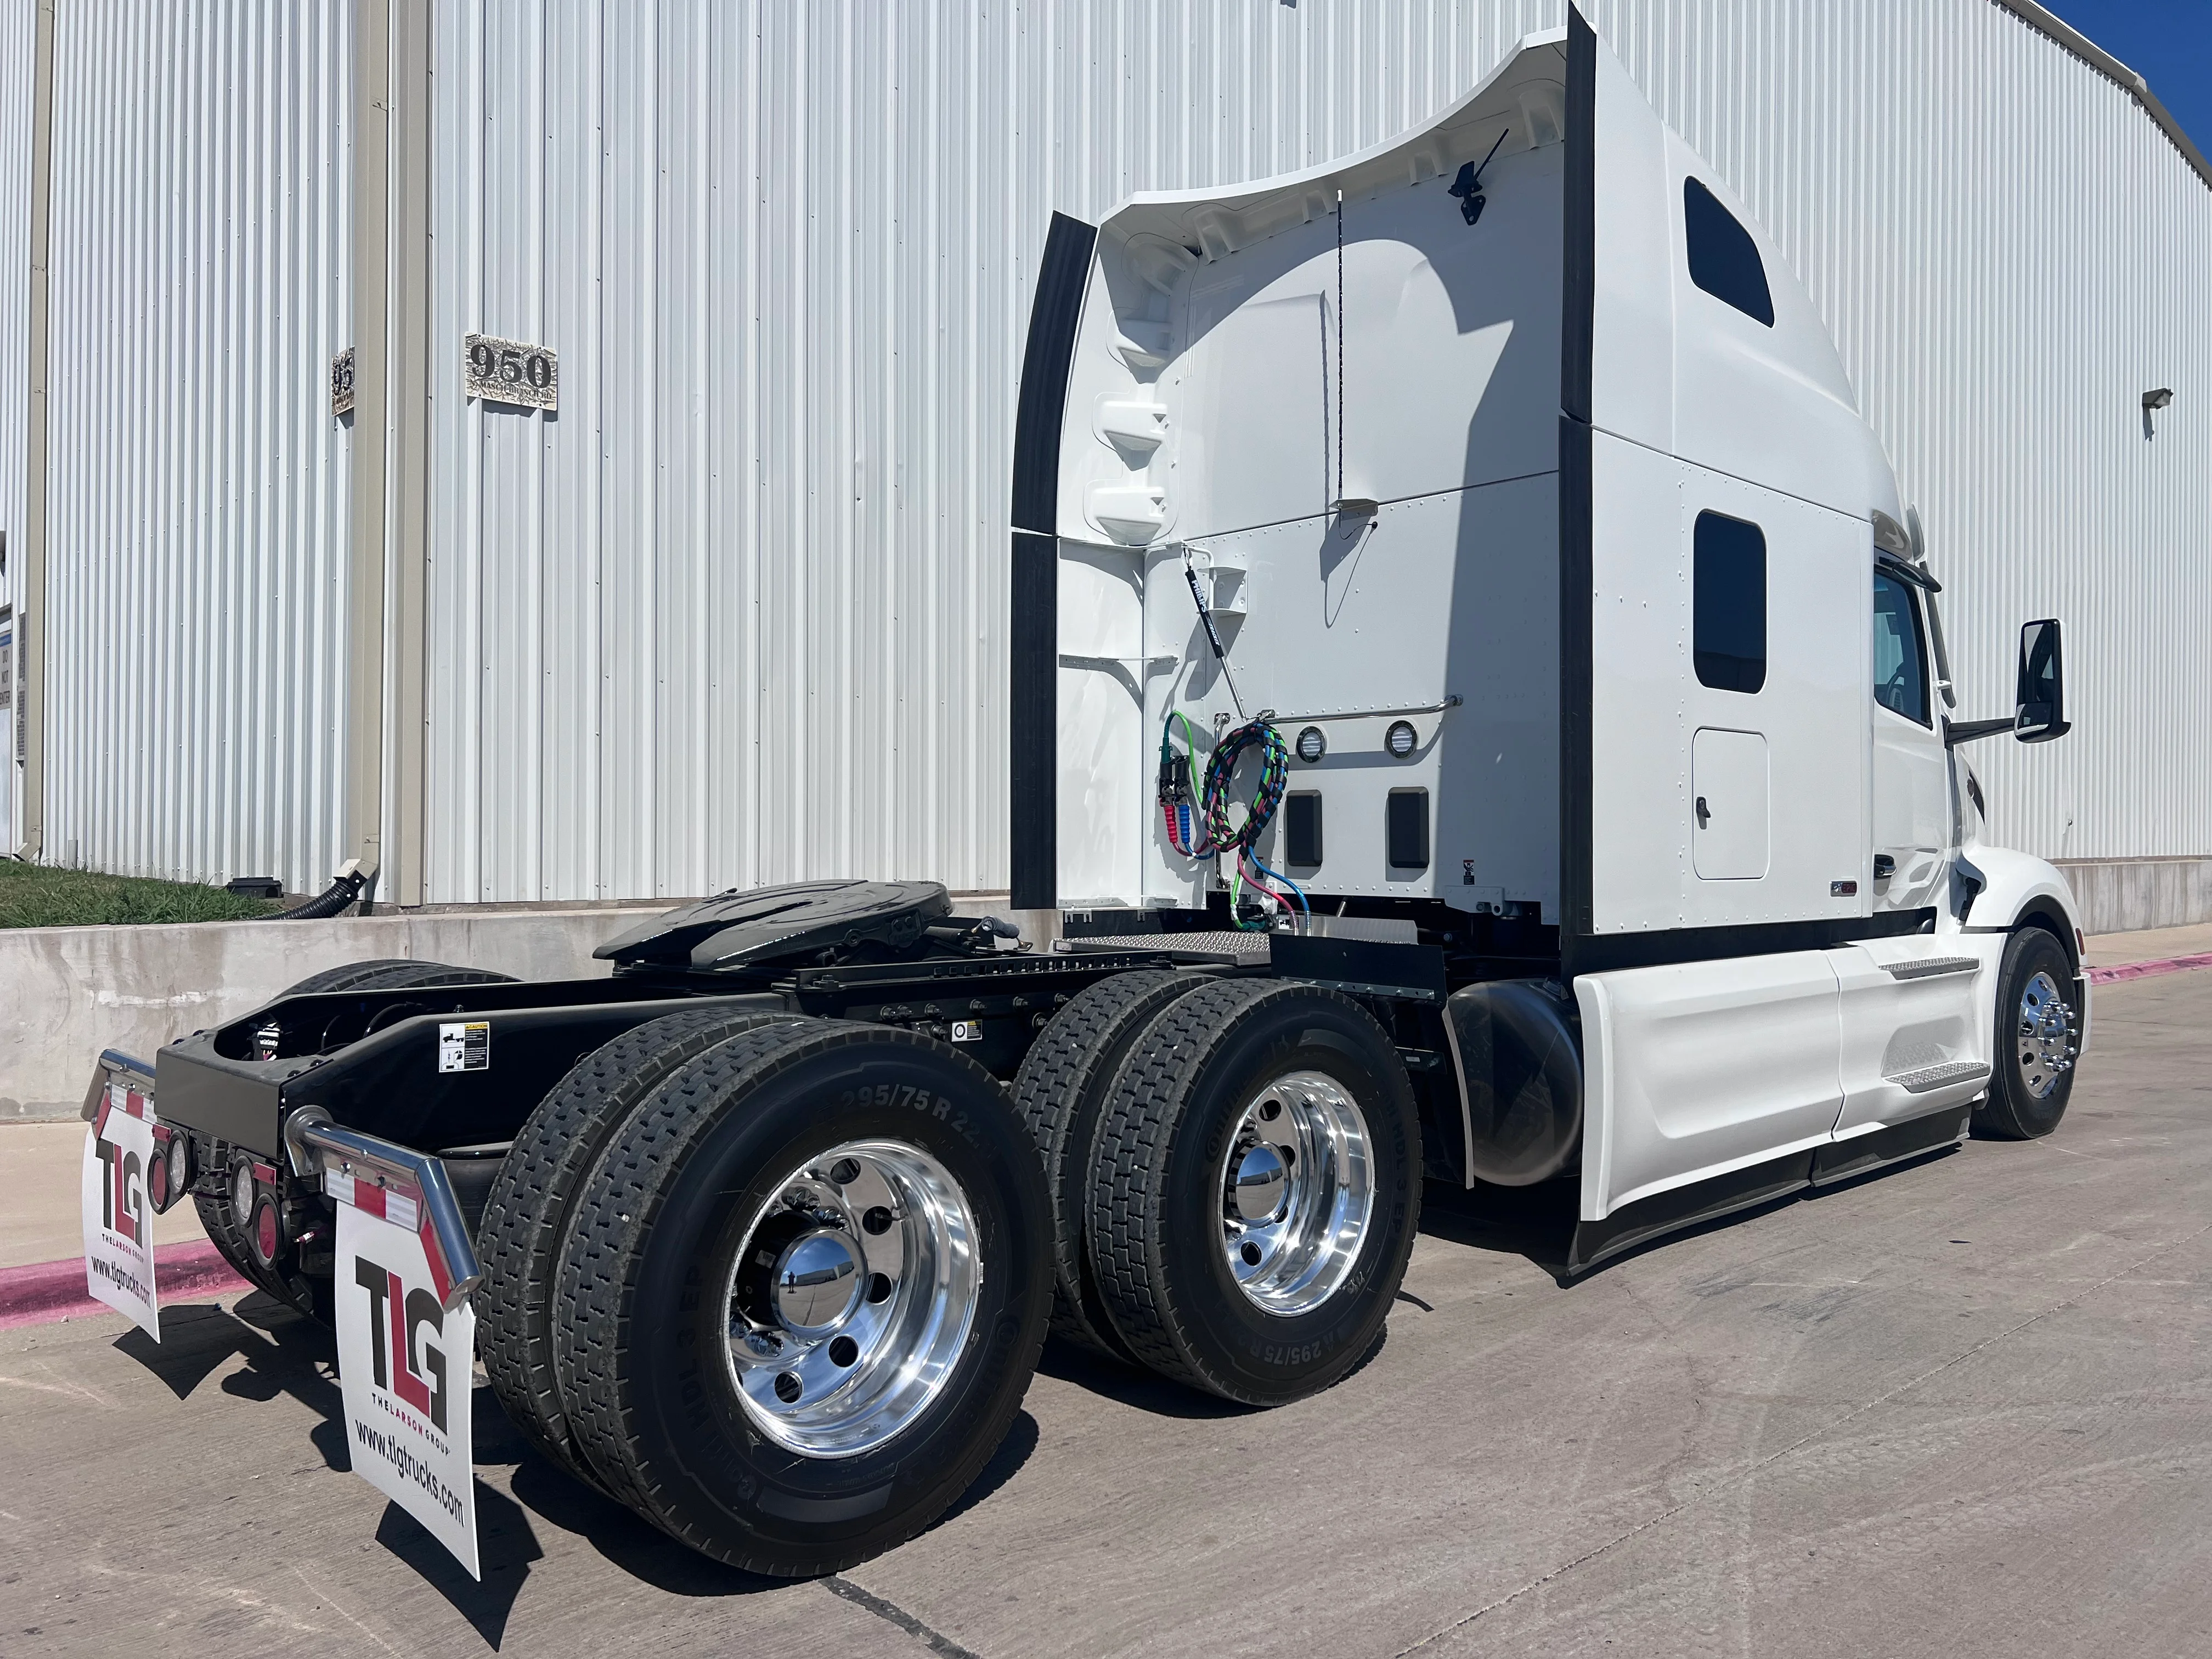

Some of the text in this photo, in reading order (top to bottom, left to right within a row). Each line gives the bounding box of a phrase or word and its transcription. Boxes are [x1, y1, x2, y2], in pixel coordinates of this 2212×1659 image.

[334, 357, 354, 396] 95
[471, 344, 551, 388] 950
[840, 1084, 932, 1111] 295/75
[932, 1096, 952, 1121] R
[95, 1137, 143, 1249] TLG
[91, 1256, 151, 1309] www.tlgtrucks.com
[355, 1255, 448, 1436] TLG
[1263, 1340, 1323, 1367] 295/75
[425, 1429, 449, 1457] GROUP
[355, 1419, 464, 1528] www.tlgtrucks.com
